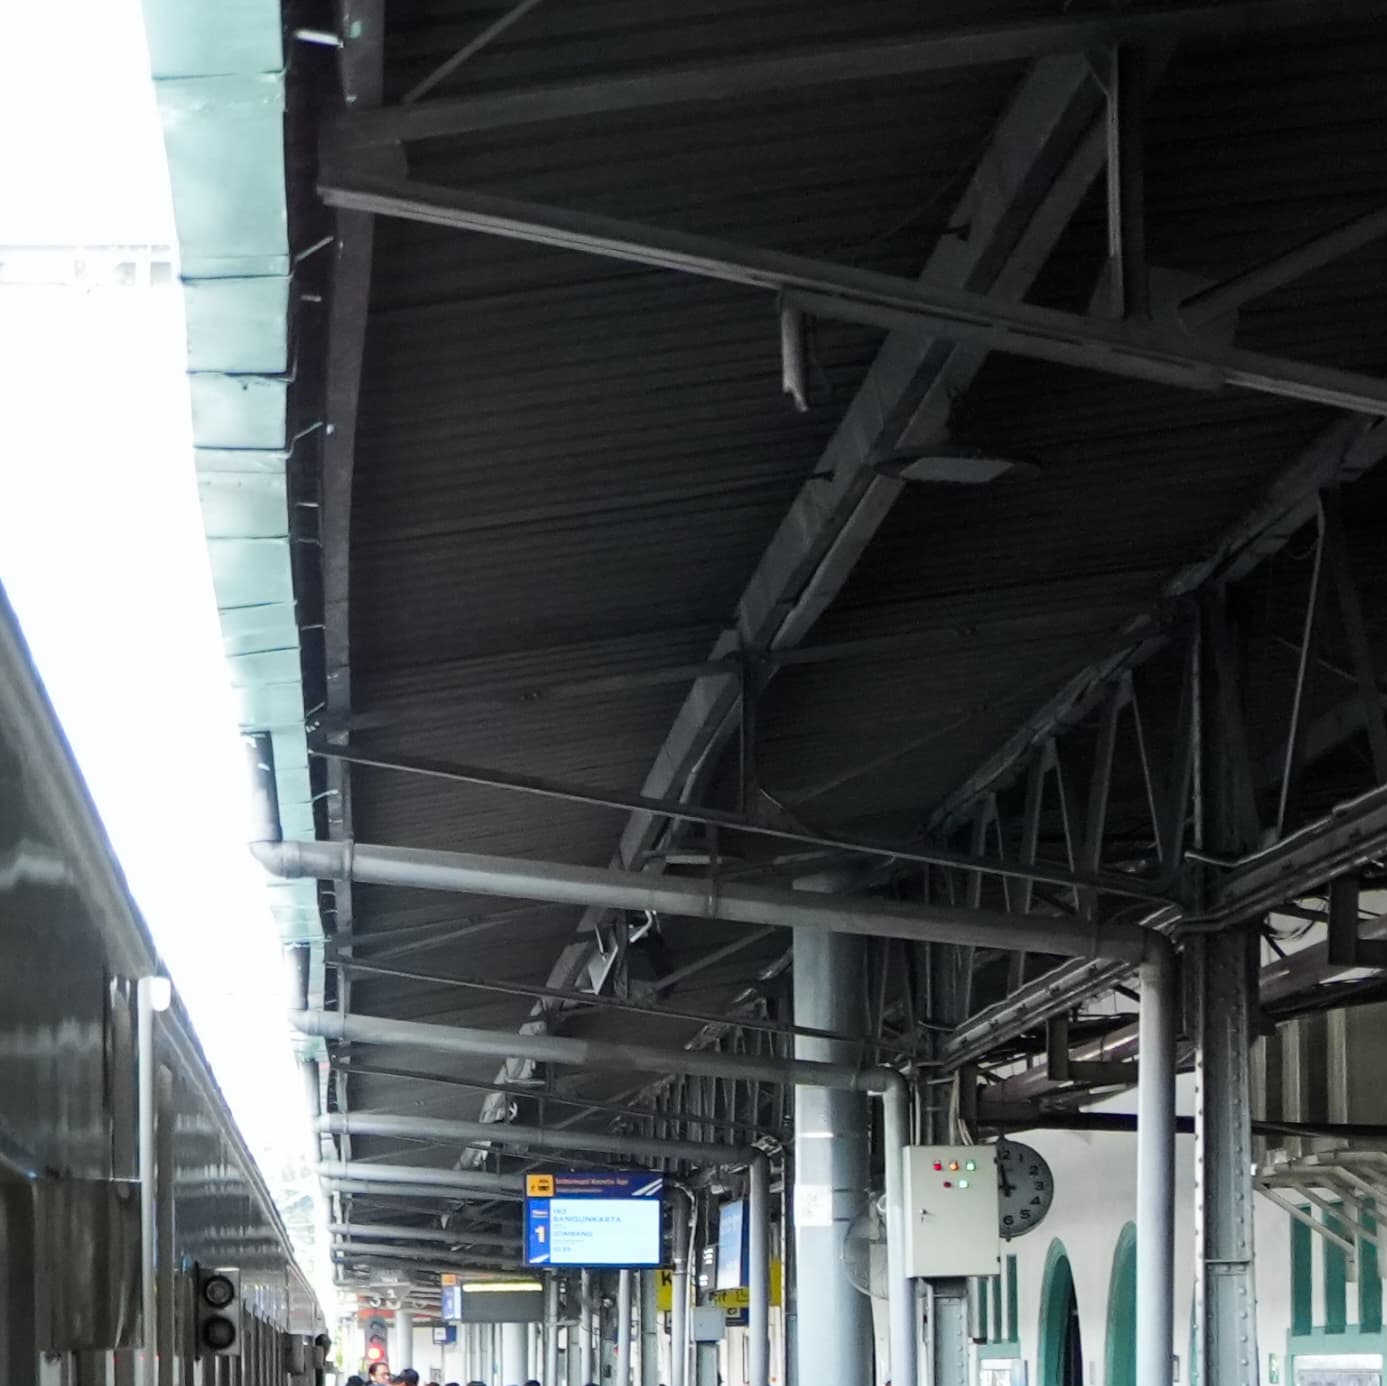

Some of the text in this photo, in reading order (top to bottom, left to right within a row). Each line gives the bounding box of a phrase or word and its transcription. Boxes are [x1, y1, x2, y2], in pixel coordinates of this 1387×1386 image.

[1029, 1165, 1039, 1176] 2
[1034, 1180, 1044, 1191] 3
[1030, 1195, 1041, 1205] 4
[1003, 1215, 1014, 1225] 6
[1020, 1209, 1031, 1220] 5
[535, 1225, 545, 1243] 1
